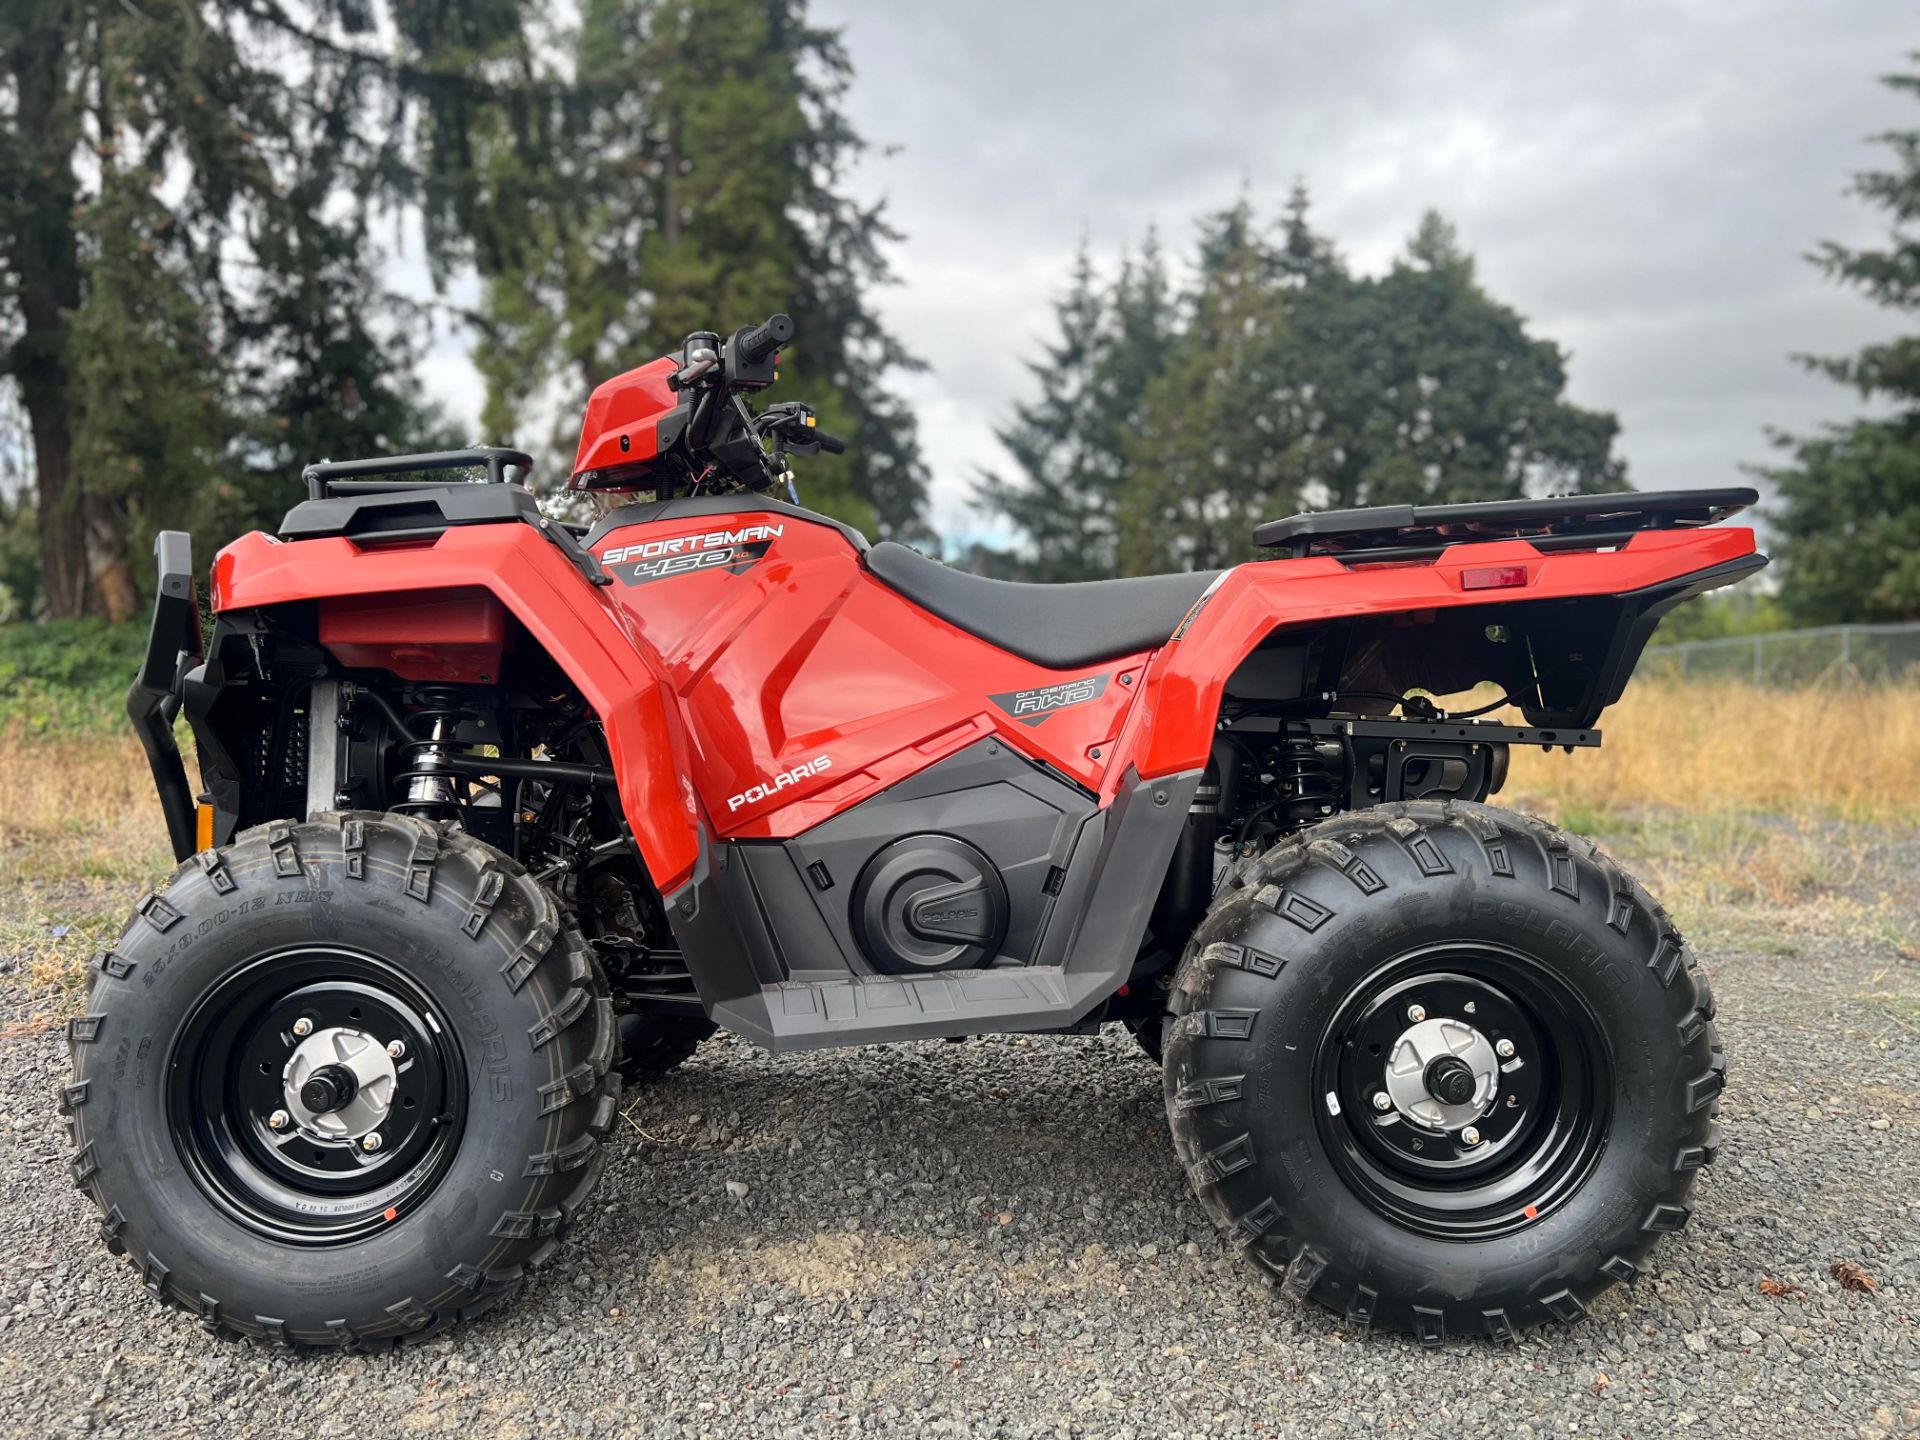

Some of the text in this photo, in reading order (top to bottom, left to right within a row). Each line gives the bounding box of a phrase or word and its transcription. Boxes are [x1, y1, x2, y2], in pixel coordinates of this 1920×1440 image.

[601, 524, 785, 566] SPORTSMAN
[634, 547, 734, 577] 450
[1014, 685, 1095, 714] AWD
[1015, 678, 1096, 699] ON DEMAND
[727, 754, 833, 813] POLARIS
[275, 889, 335, 906] NHS
[922, 908, 978, 923] POLARIS
[1471, 898, 1631, 992] POLARIS
[424, 948, 513, 1102] POLARIS
